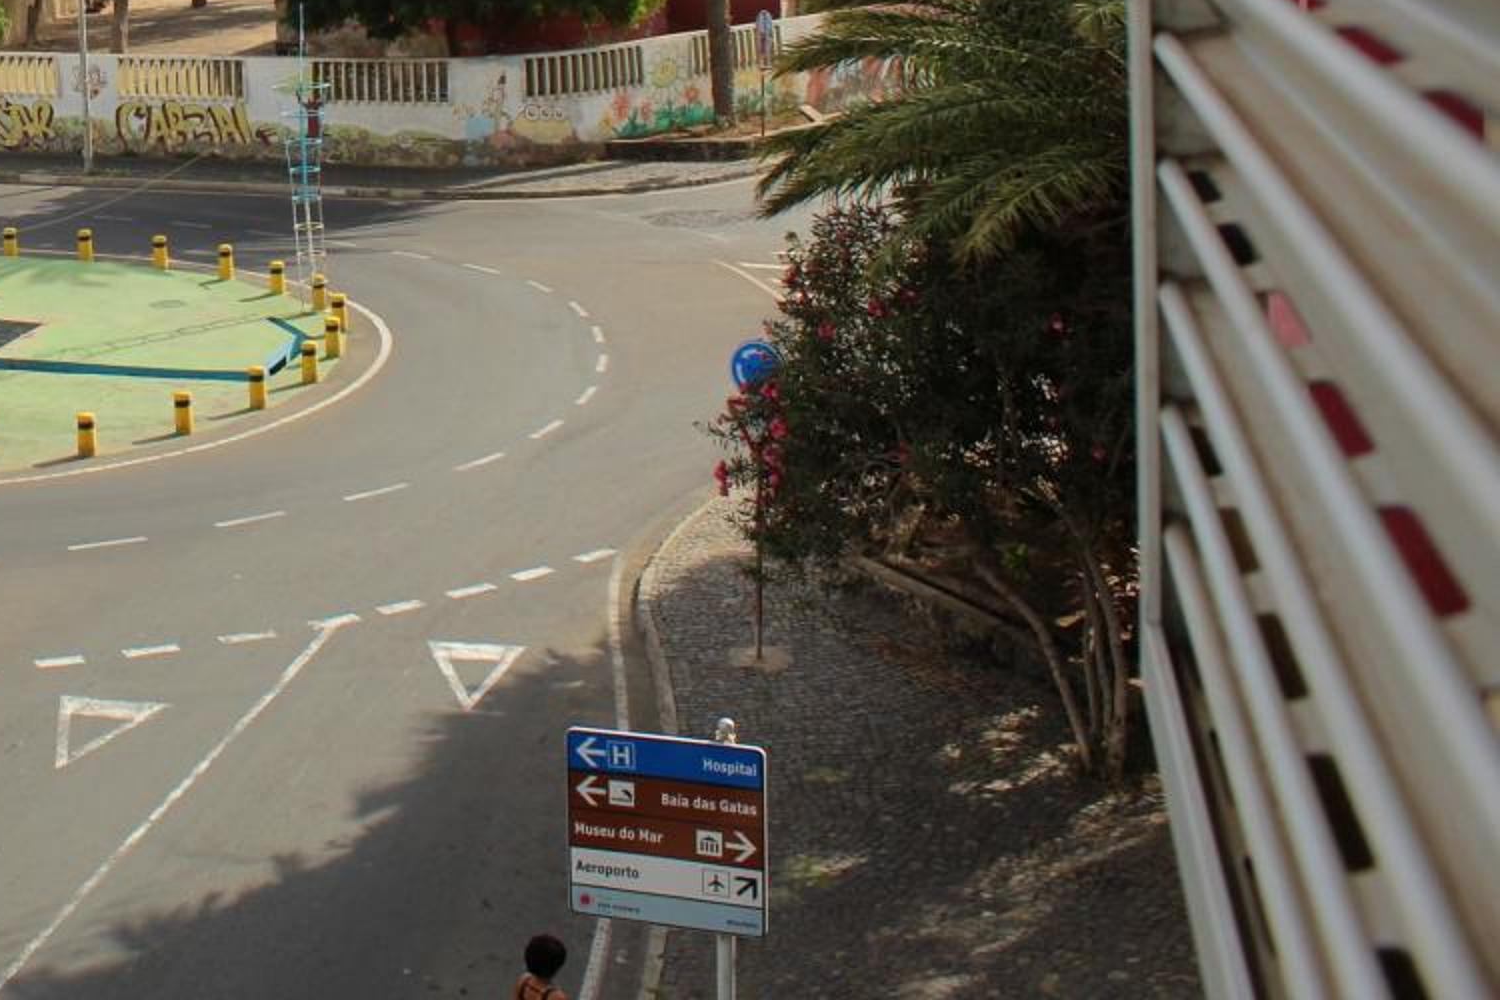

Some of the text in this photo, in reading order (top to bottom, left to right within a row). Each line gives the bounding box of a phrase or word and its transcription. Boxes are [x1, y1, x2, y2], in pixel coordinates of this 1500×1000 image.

[612, 745, 757, 777] H Hospital
[693, 796, 715, 811] das
[719, 799, 757, 816] Gatas
[574, 822, 664, 843] Museu do Mar
[576, 860, 640, 880] Aeroporto
